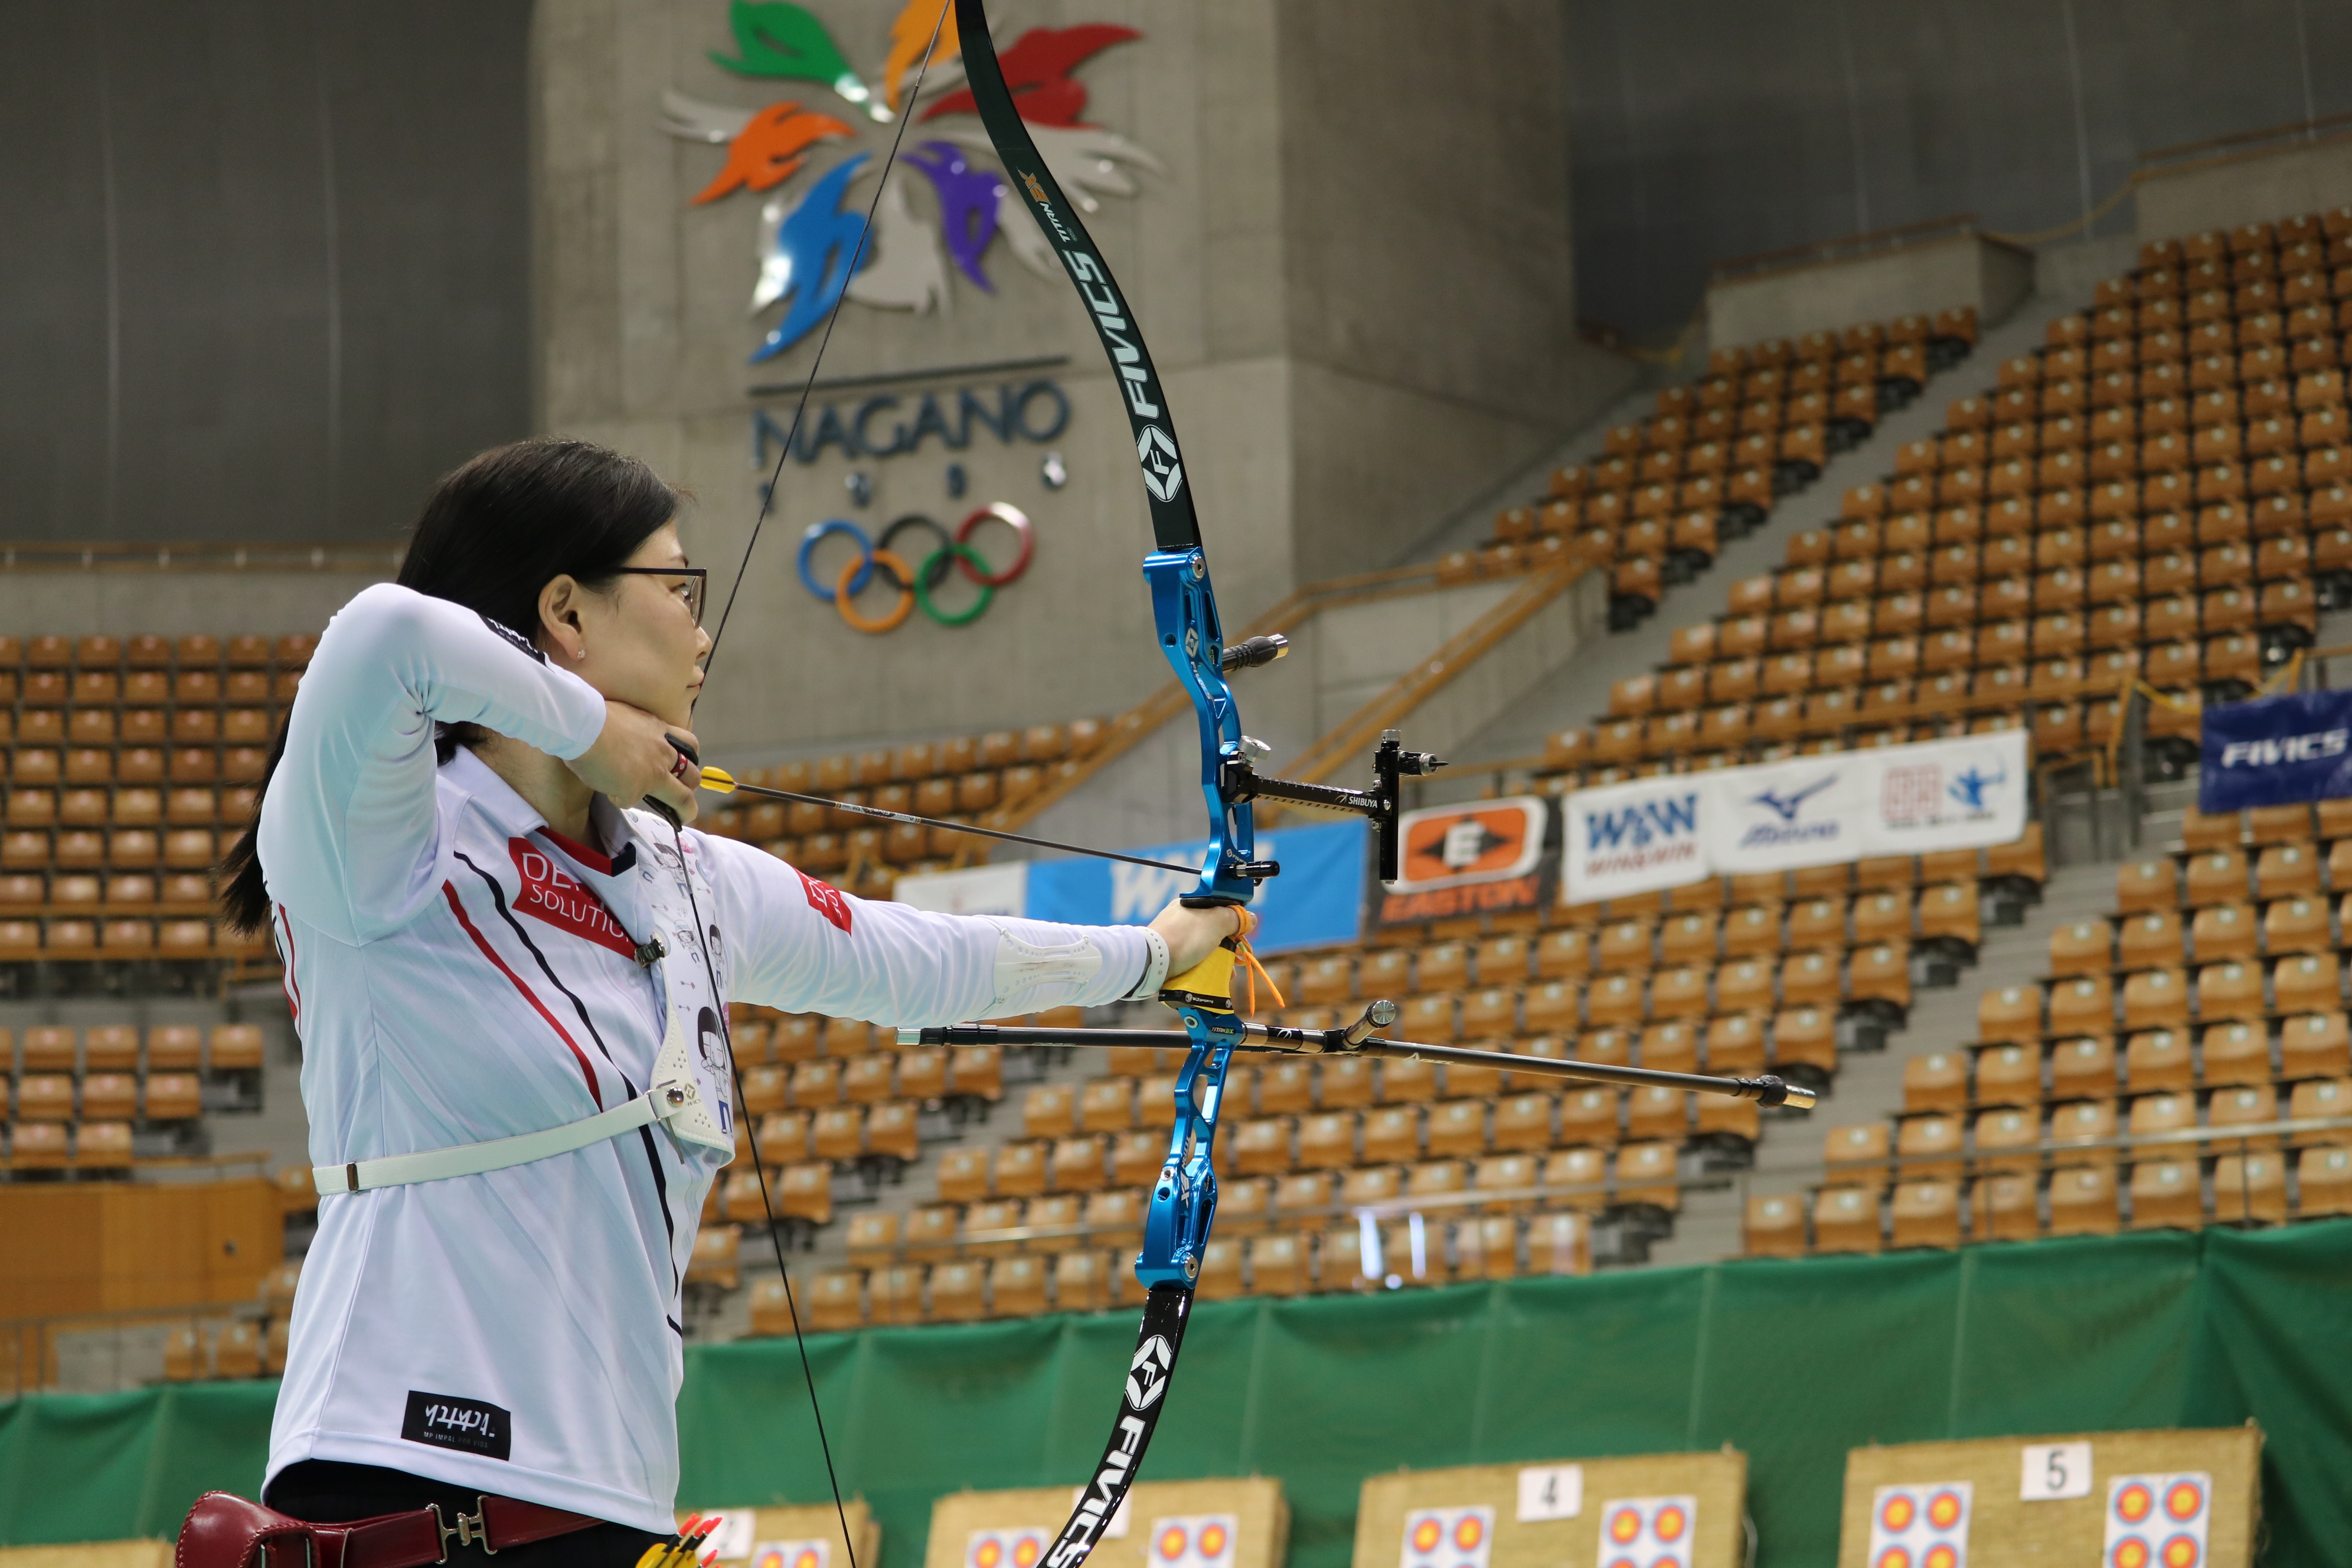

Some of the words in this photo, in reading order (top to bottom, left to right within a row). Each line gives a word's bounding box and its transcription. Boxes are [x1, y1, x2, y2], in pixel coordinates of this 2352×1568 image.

[1062, 249, 1159, 419] FIVICS
[750, 380, 1070, 470] NAGANO
[2220, 728, 2349, 769] FIVICS
[1348, 796, 1378, 808] SHIBUYA
[530, 884, 629, 943] SOLUTIO
[1380, 875, 1540, 923] EASTON
[435, 1433, 455, 1443] IMPAL
[458, 1437, 471, 1445] POR
[473, 1440, 488, 1449] VIDA
[1538, 1474, 1558, 1510] 4
[2045, 1449, 2068, 1492] 5
